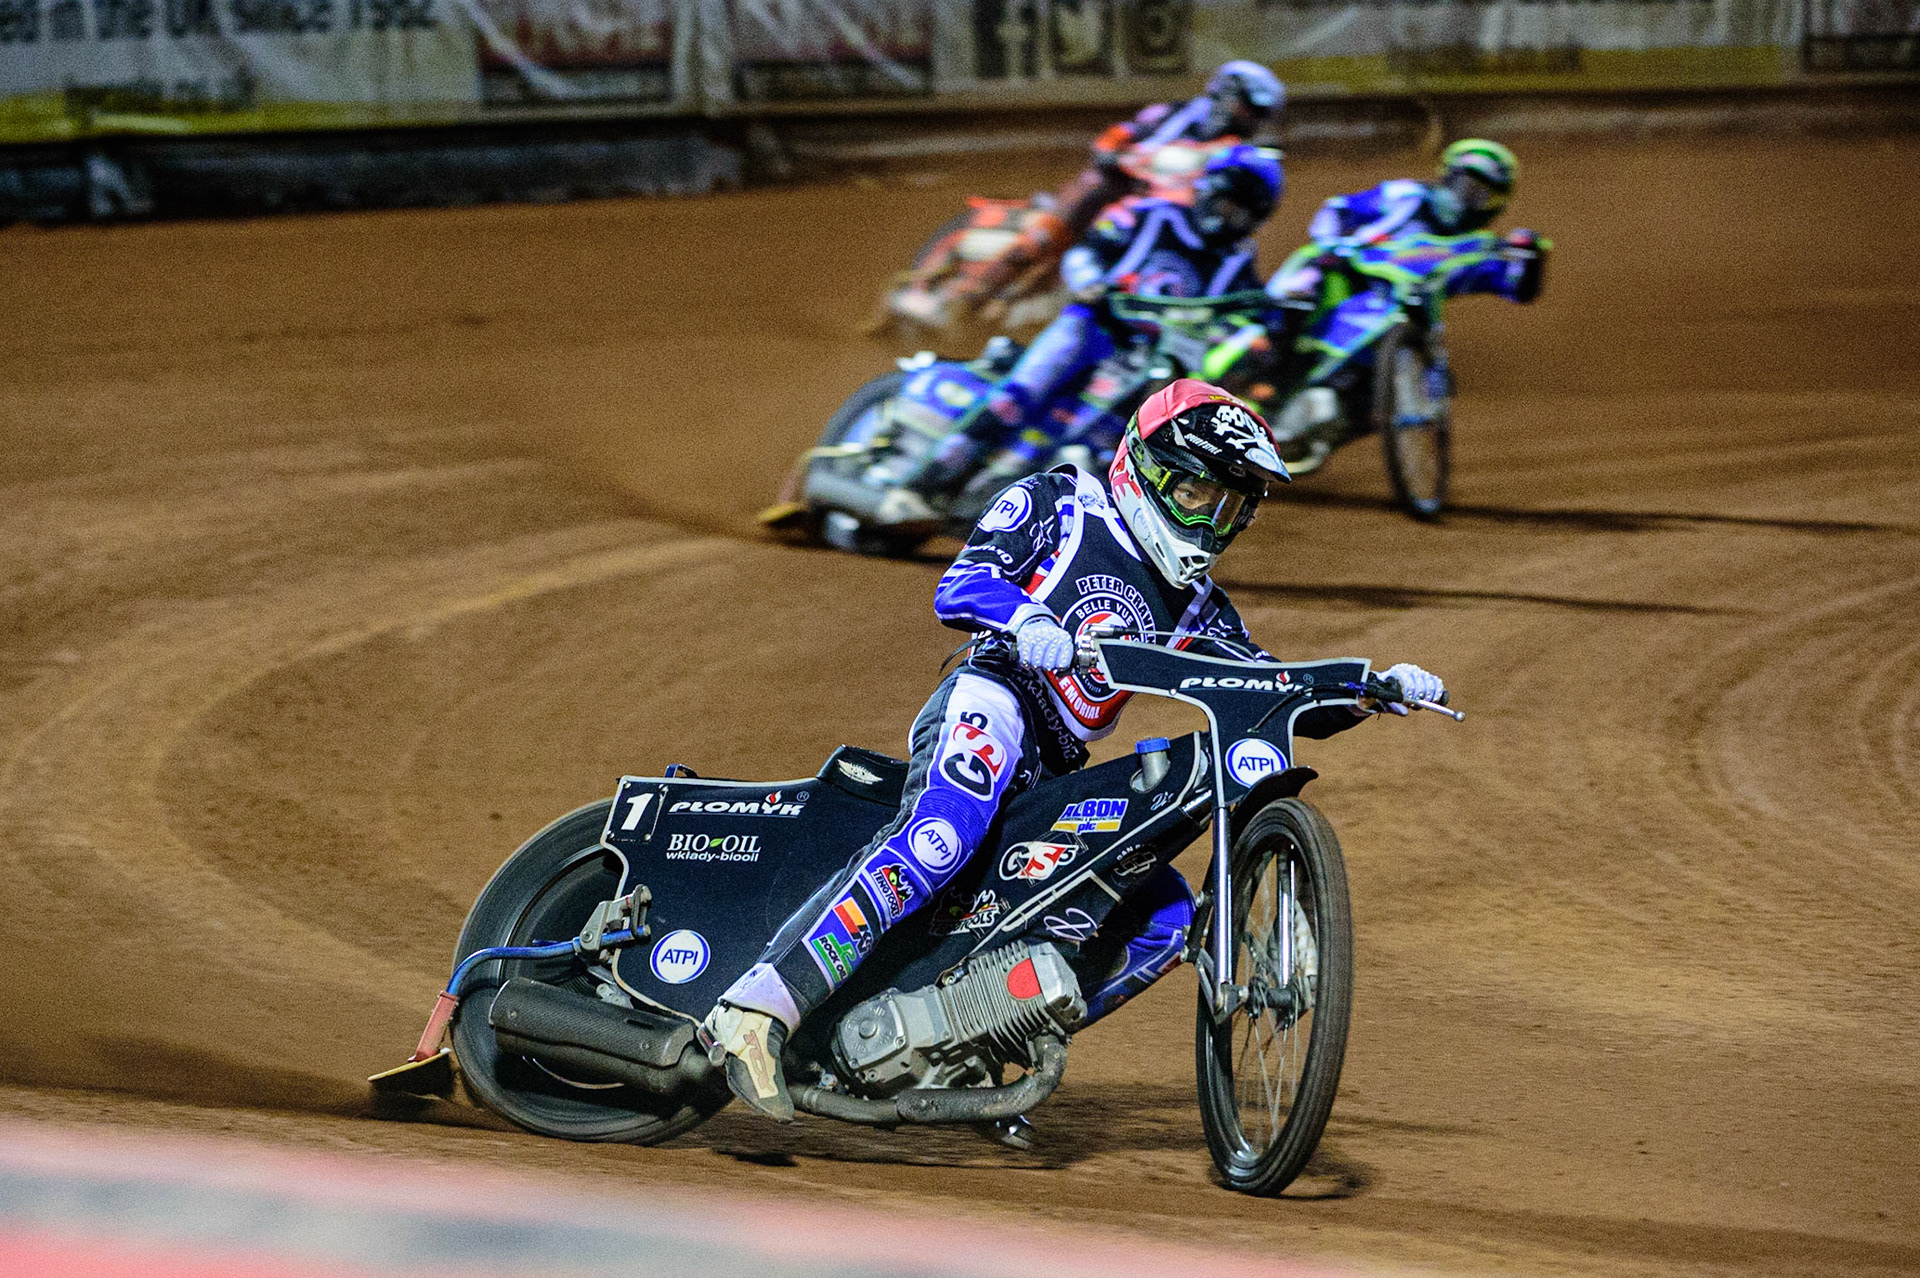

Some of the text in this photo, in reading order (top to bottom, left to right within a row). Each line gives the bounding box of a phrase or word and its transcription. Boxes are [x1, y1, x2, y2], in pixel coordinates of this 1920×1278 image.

[995, 500, 1018, 519] TPI
[1075, 575, 1124, 595] PETER
[1075, 600, 1134, 626] BELLE VUE
[1058, 676, 1100, 719] EMORIAL
[1237, 756, 1275, 772] ATPI
[620, 793, 654, 831] 1
[1060, 800, 1126, 818] ALBON
[1077, 821, 1097, 834] plc
[920, 828, 952, 860] ATPI
[660, 949, 699, 966] ATPI
[819, 936, 841, 964] ROCK
